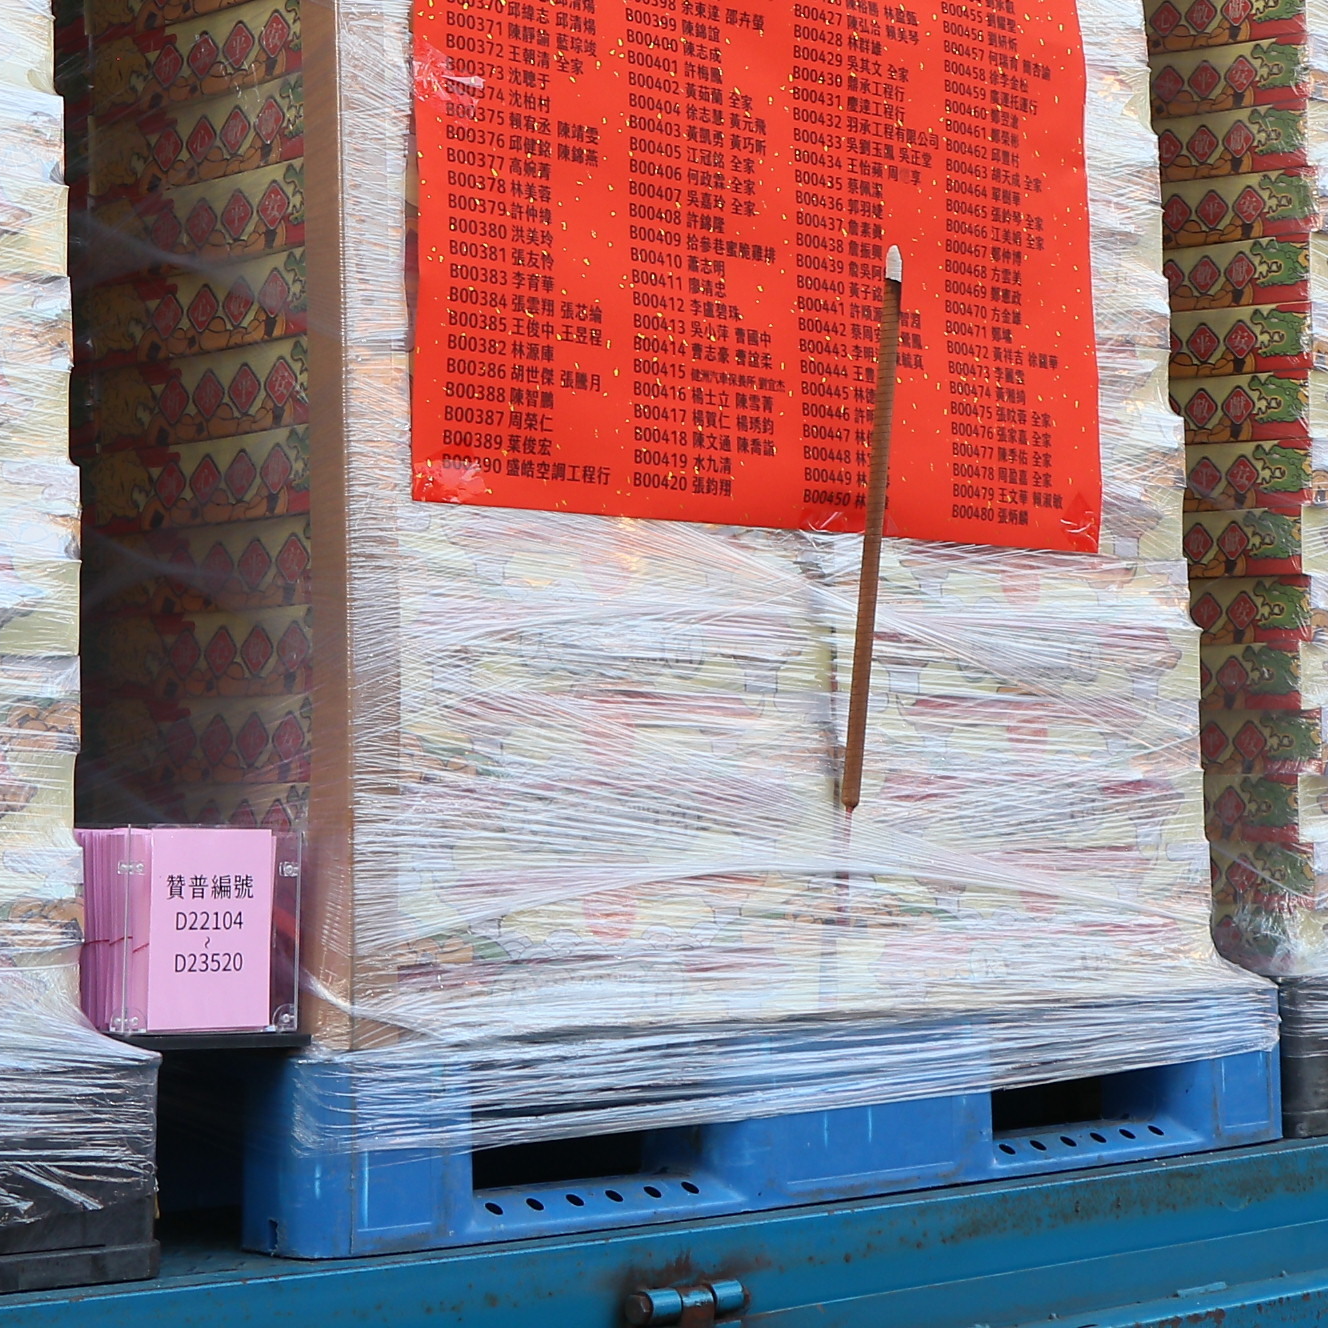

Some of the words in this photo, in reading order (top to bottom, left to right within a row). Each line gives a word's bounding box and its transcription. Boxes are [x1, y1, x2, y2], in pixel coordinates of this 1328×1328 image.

[793, 44, 843, 67] B00429
[793, 107, 842, 129] B00432
[448, 216, 507, 239] B00380
[945, 259, 987, 279] B00468
[448, 309, 507, 332] B00385
[444, 405, 504, 426] B00387
[634, 449, 688, 469] B00419
[166, 874, 254, 900] 贊普編號
[175, 911, 244, 931] D22104
[174, 953, 243, 972] D23520
